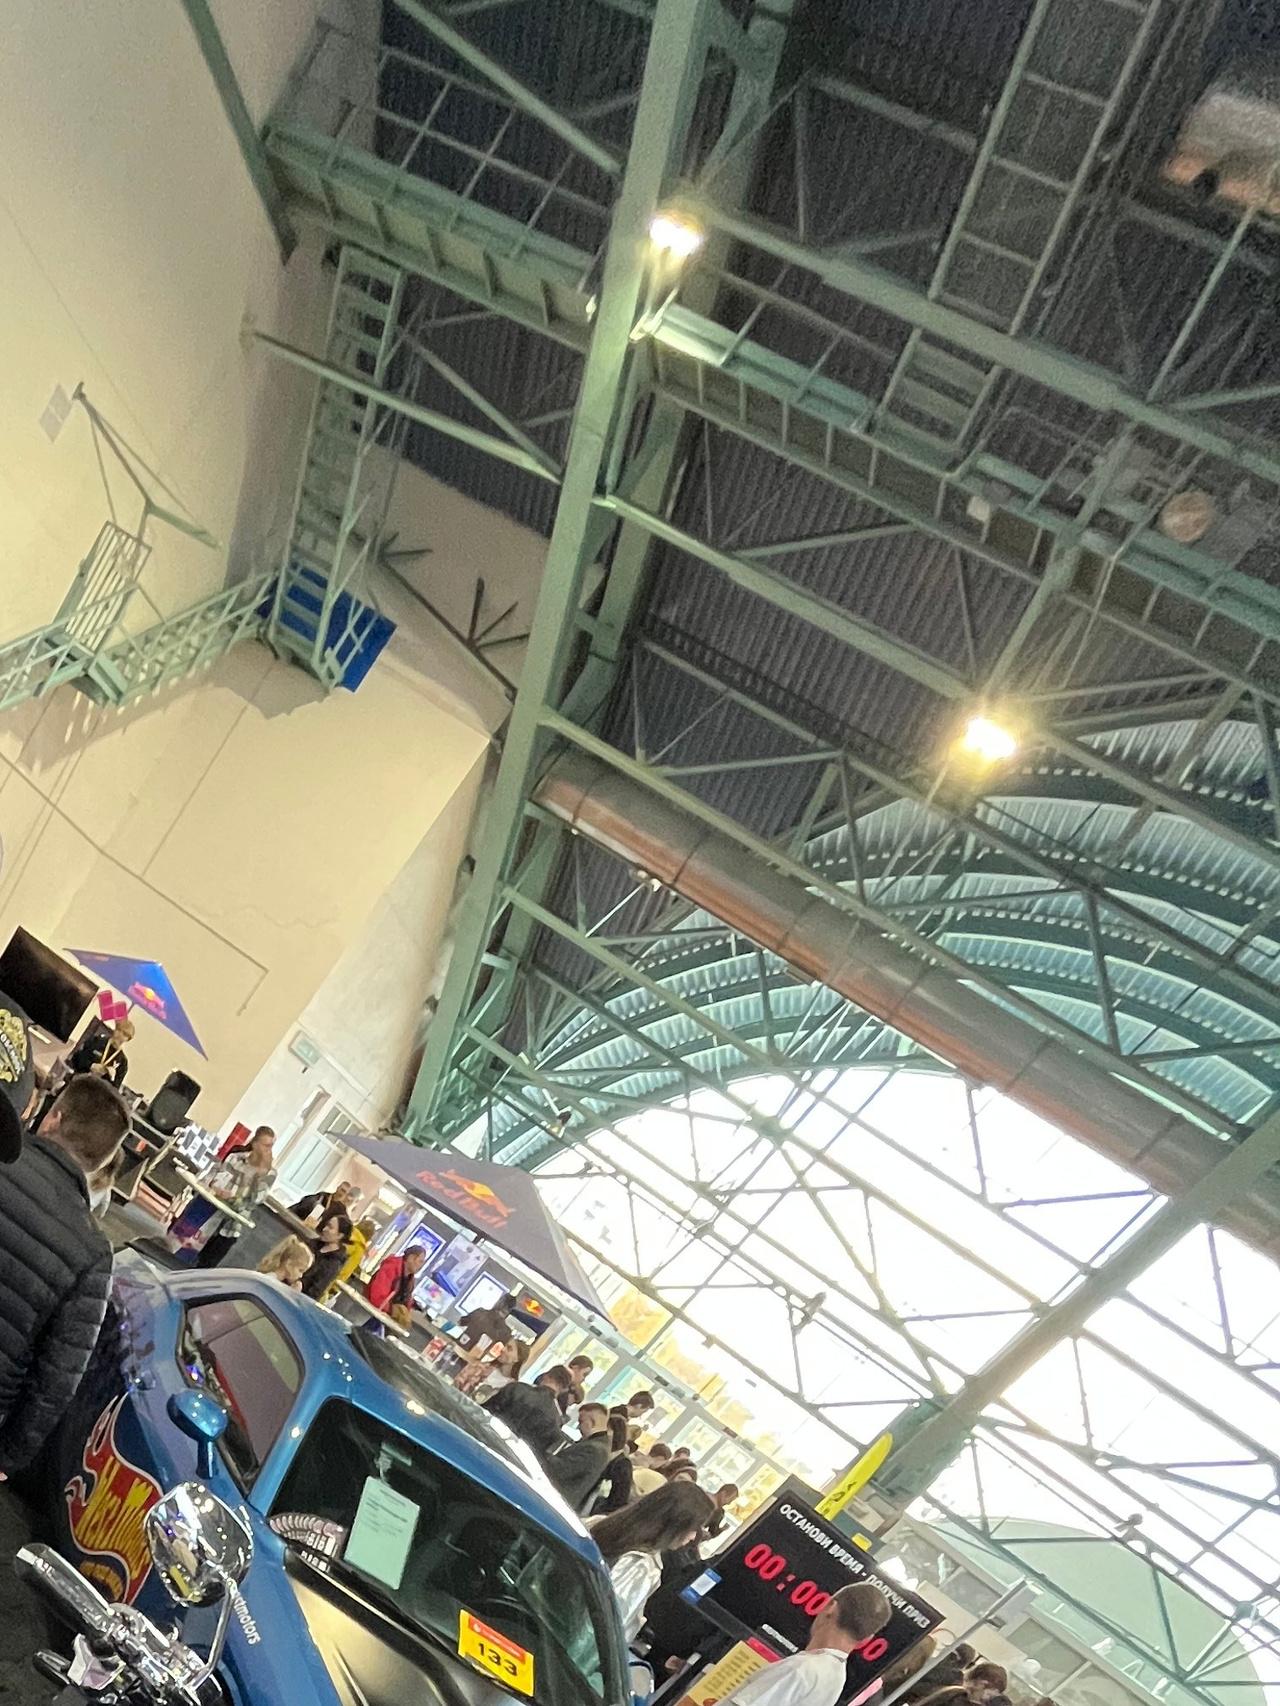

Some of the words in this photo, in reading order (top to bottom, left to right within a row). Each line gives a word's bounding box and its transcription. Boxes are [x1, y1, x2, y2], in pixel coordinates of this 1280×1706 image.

[779, 1503, 830, 1550] ОСТАНОВИ
[828, 1543, 865, 1575] ВРЕМЯ
[867, 1573, 904, 1611] ПОЛУЧИ
[902, 1602, 931, 1630] ПРИЗ
[478, 1642, 518, 1677] 133
